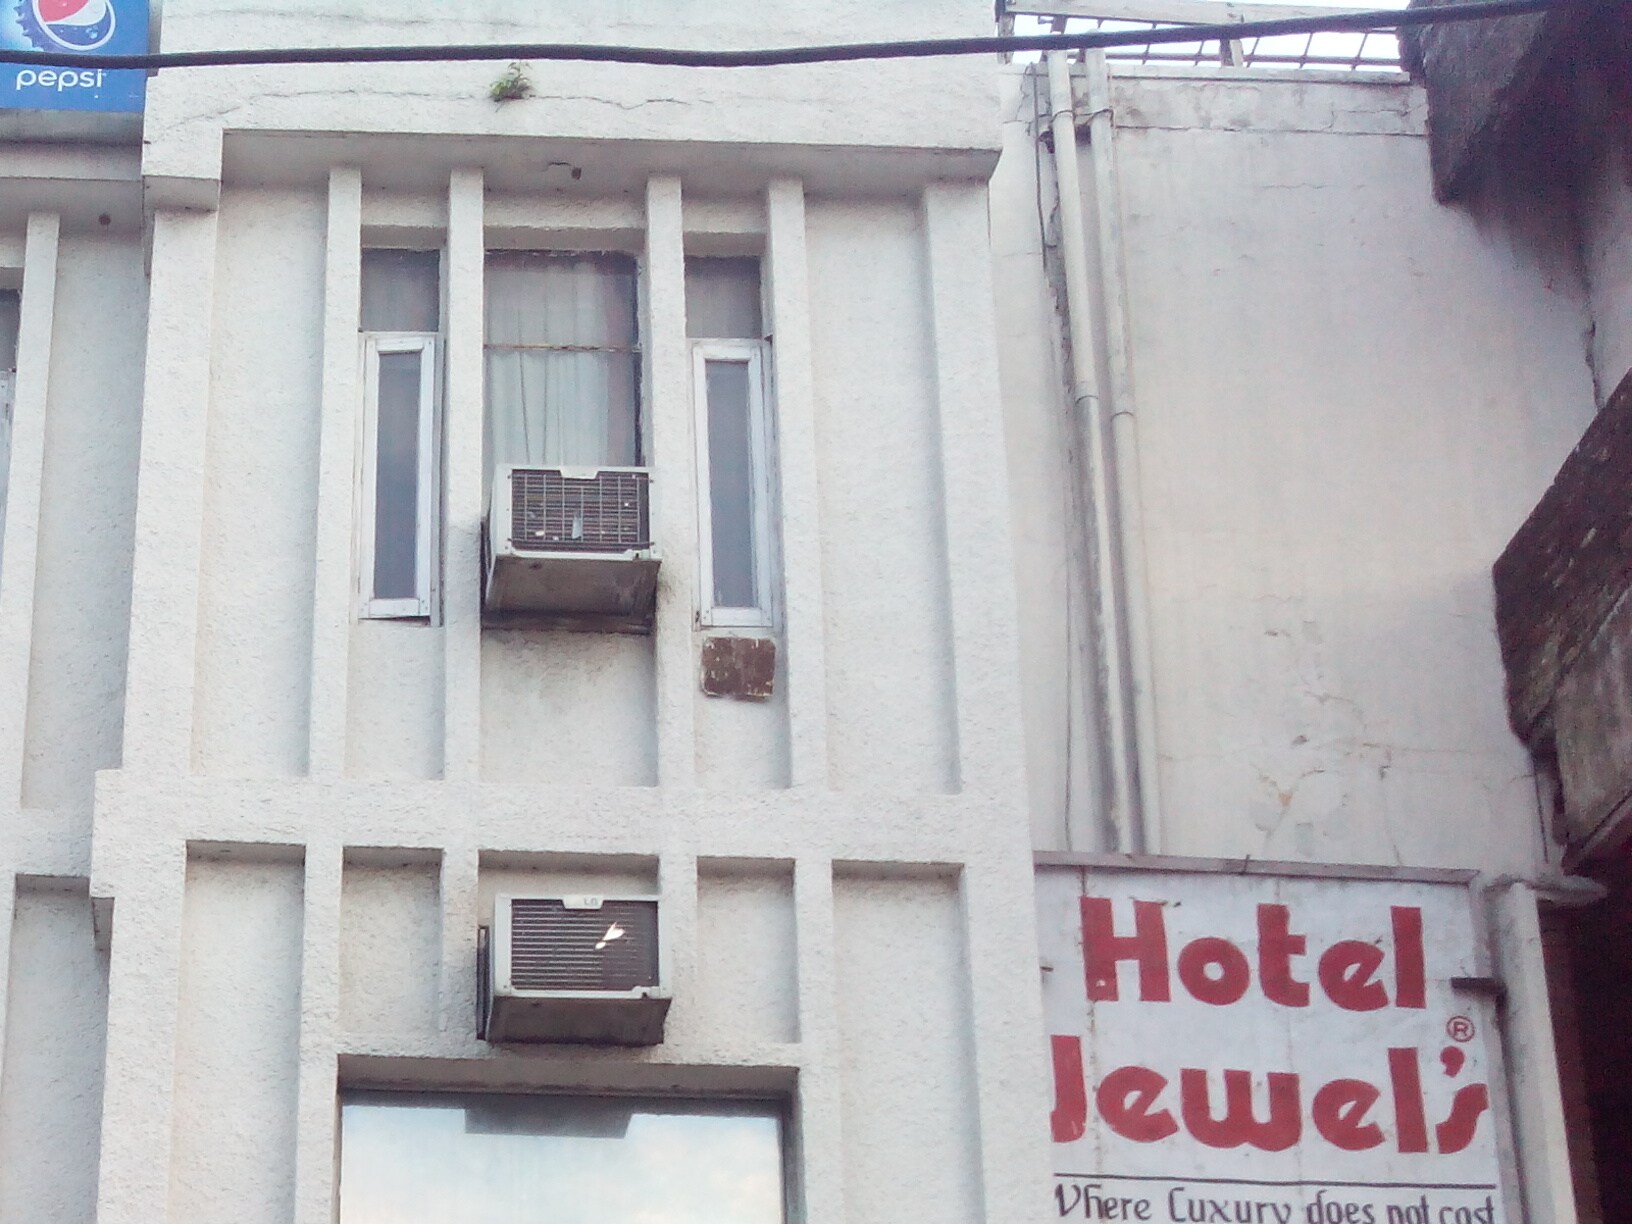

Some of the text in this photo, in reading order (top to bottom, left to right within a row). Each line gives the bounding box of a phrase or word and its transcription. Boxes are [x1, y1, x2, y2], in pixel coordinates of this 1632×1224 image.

[16, 69, 103, 92] pepsi
[1079, 896, 1428, 1012] Hotel
[1050, 1034, 1489, 1155] Jewel's
